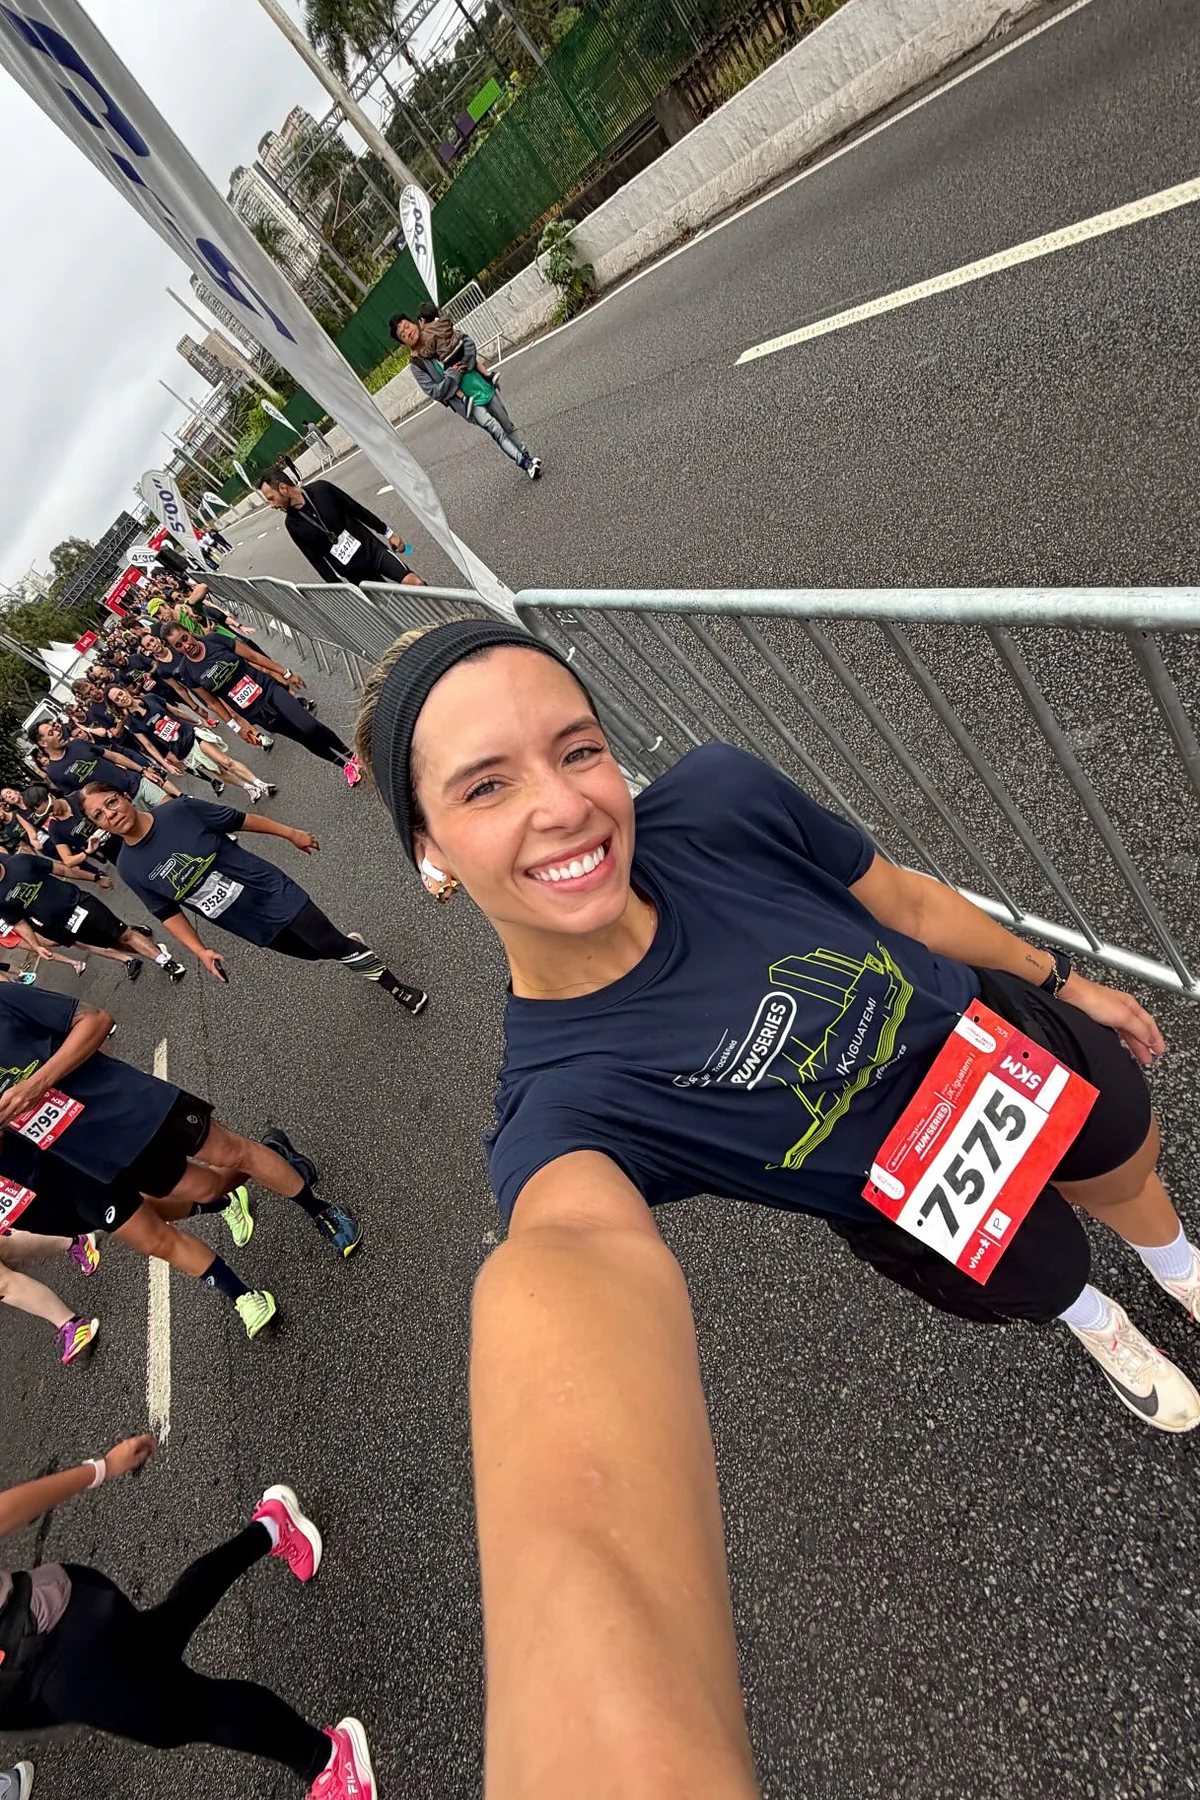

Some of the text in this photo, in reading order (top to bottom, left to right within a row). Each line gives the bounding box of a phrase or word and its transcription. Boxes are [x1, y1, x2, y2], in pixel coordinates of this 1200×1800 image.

[152, 477, 186, 533] 5'00"
[201, 888, 227, 912] 3528
[999, 1055, 1042, 1090] 5KM
[26, 1106, 60, 1139] 5795
[919, 1088, 1027, 1239] 7575
[968, 1248, 986, 1270] vivo
[344, 1761, 359, 1795] FILA
